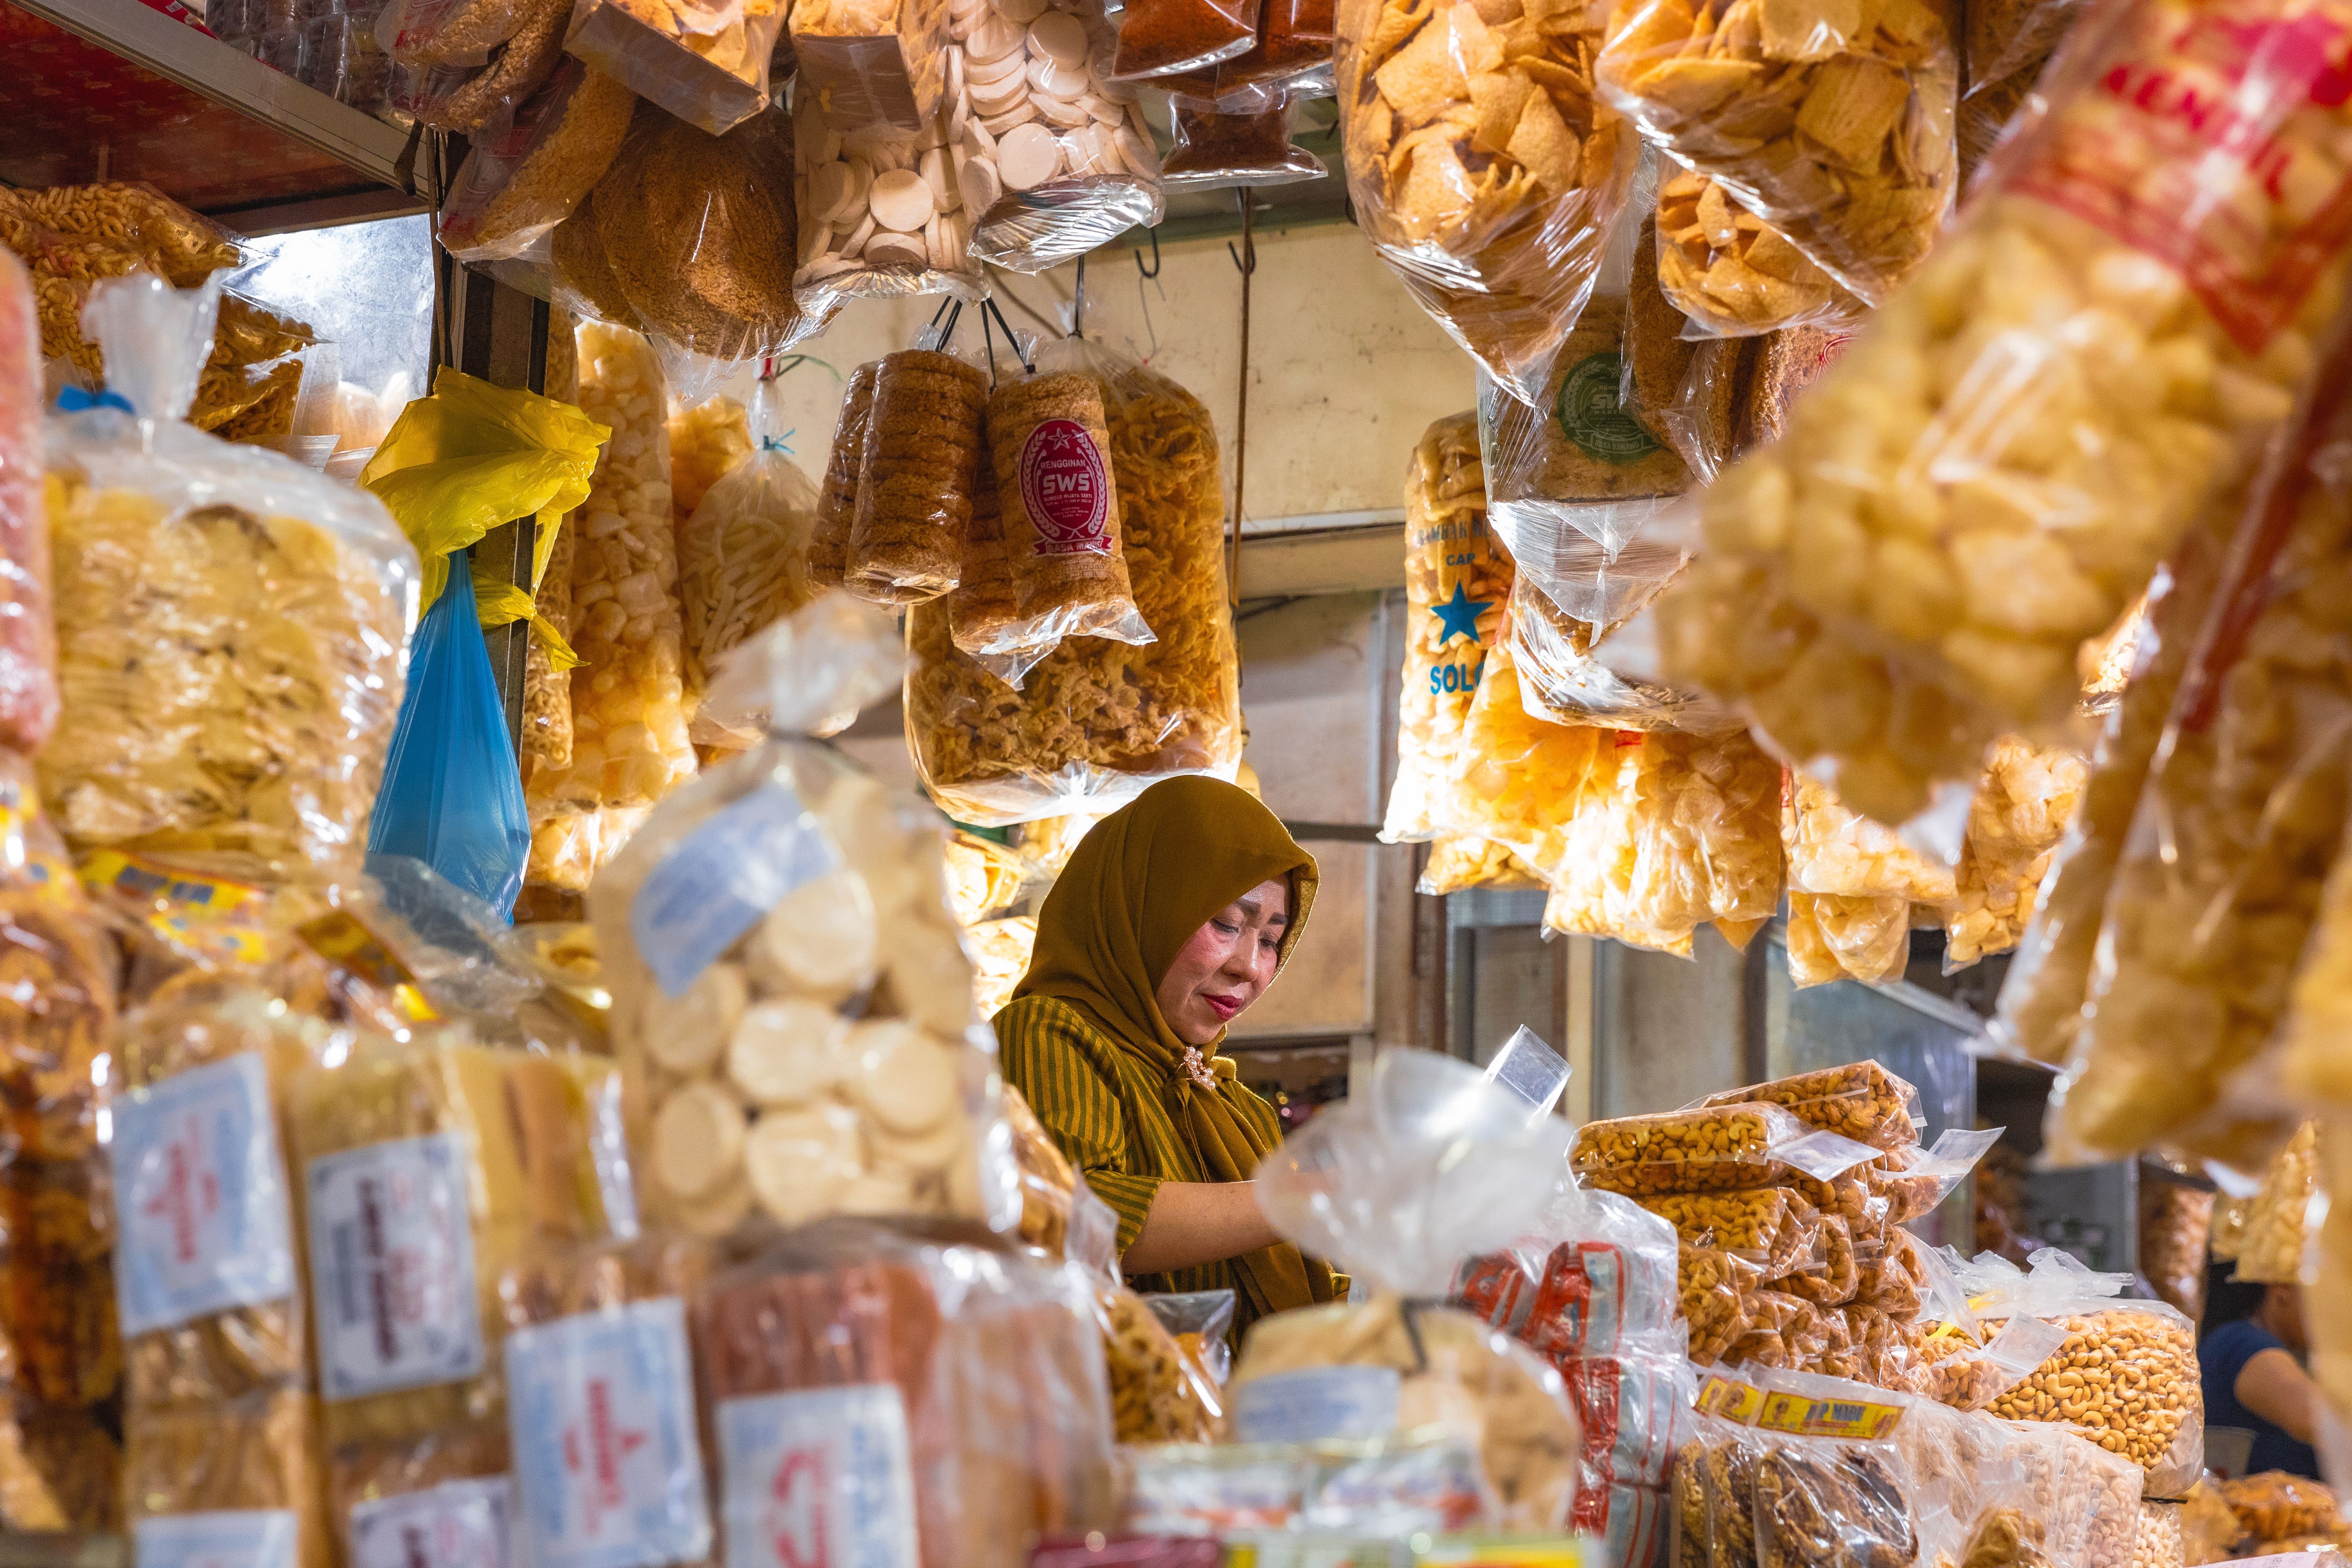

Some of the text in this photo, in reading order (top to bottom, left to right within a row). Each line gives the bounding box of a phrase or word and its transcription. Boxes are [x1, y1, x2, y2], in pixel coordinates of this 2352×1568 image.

[1594, 439, 1640, 451] RASA BAWANG
[1040, 459, 1086, 469] RENGGINAN
[1043, 473, 1090, 495] SWS
[1048, 543, 1074, 553] RASA
[1446, 553, 1476, 567] CAP
